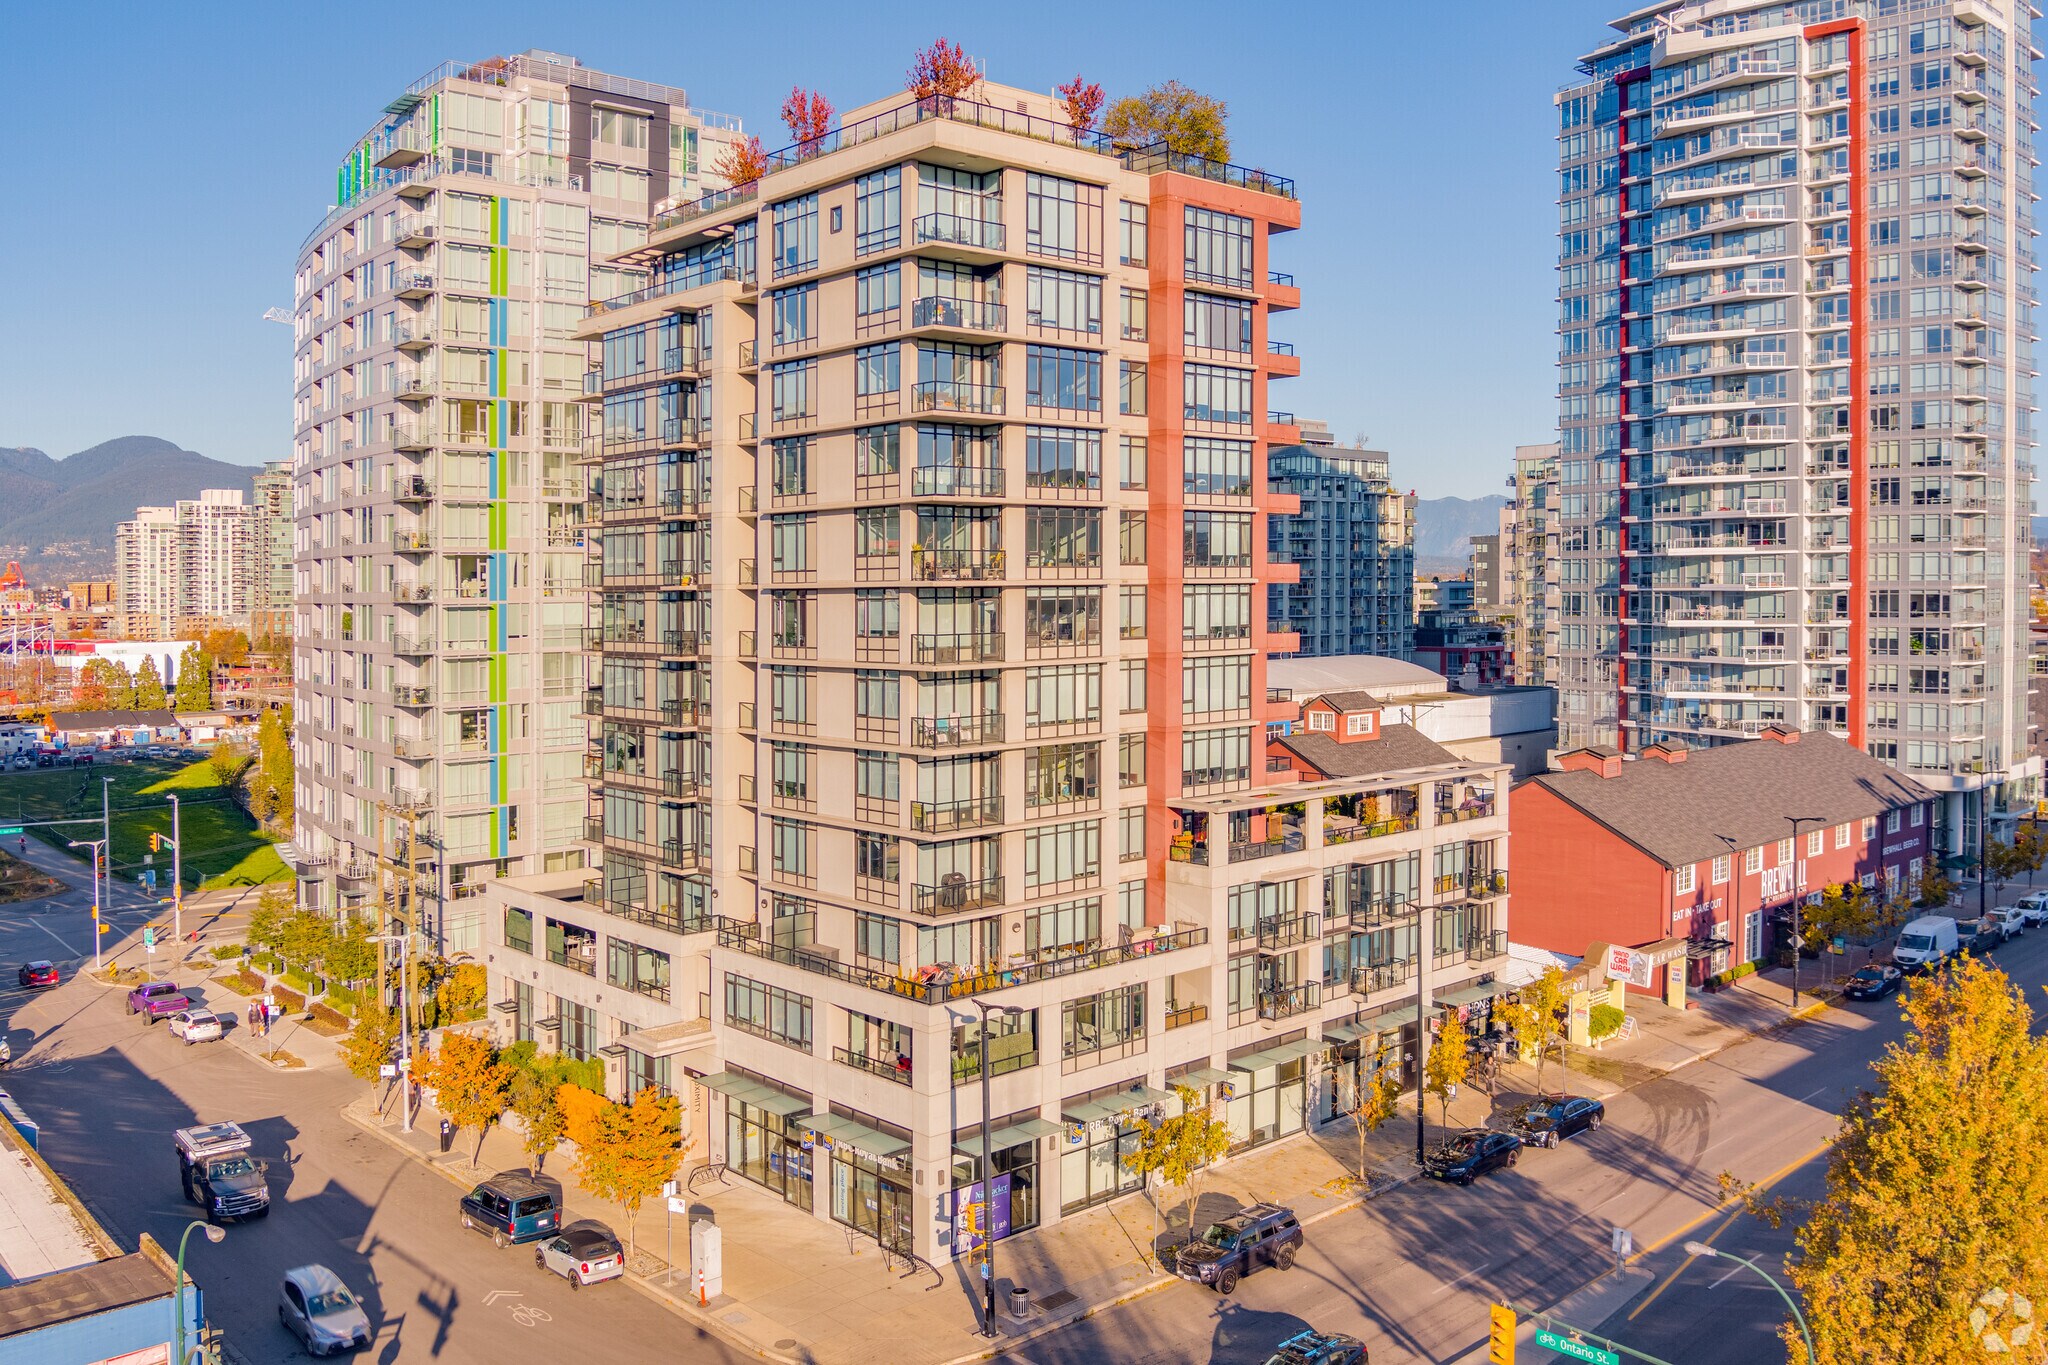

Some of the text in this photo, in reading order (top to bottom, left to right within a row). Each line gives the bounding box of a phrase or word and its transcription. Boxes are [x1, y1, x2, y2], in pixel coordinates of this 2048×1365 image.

[1761, 859, 1807, 899] BREWHLL
[1673, 898, 1722, 921] EAT IN TAKE OUT
[1613, 949, 1630, 959] HAND
[1667, 945, 1687, 959] WASH
[1610, 962, 1631, 974] WASH
[1614, 956, 1628, 966] CAR
[1560, 1340, 1610, 1365] Ontario St.
